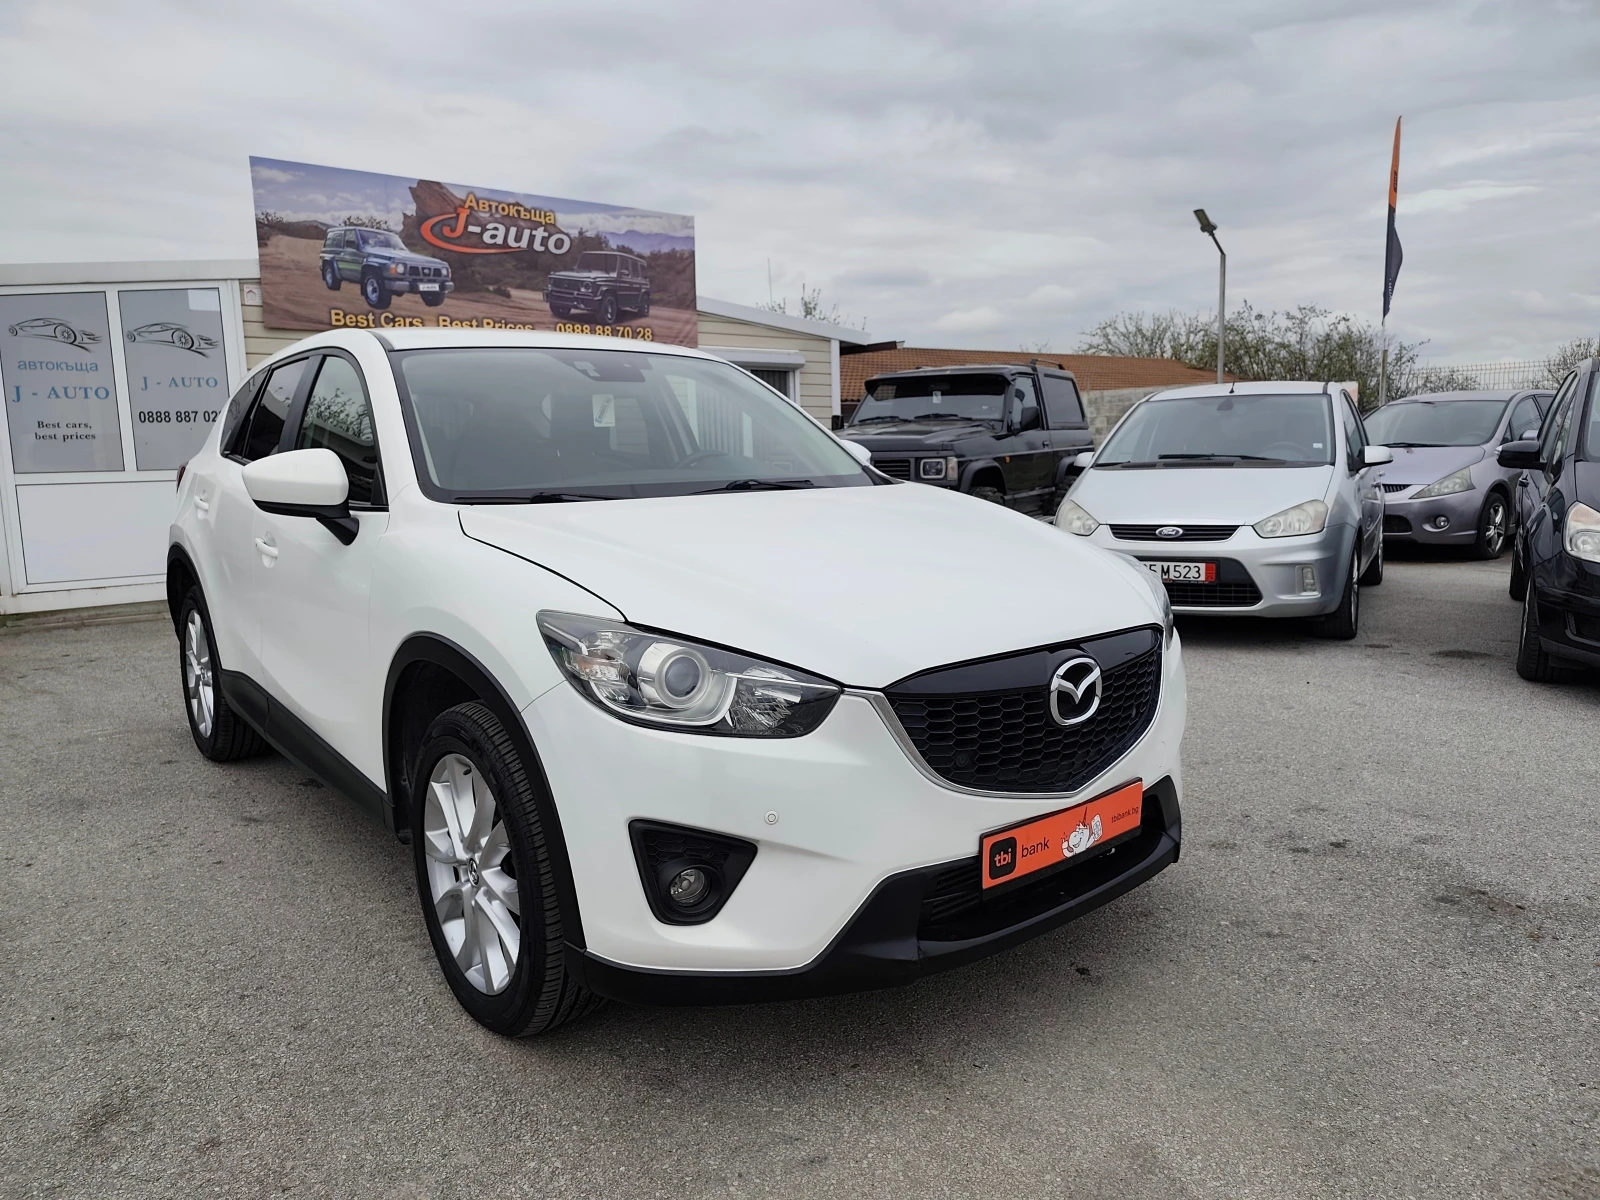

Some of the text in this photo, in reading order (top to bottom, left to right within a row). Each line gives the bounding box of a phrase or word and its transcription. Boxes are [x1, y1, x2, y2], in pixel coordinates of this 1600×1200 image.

[464, 193, 556, 225] Автокъща
[441, 207, 571, 255] J-auto
[330, 309, 376, 328] Best
[380, 312, 423, 328] Cars
[17, 360, 99, 373] автокъща
[141, 376, 149, 391] J
[168, 376, 219, 388] AUTO
[12, 385, 22, 403] J
[46, 386, 110, 400] AUTO
[138, 410, 221, 423] 0888 887 02
[37, 420, 92, 430] Best cars,
[34, 432, 97, 442] best prices
[1111, 807, 1139, 823] tbibank.bg
[994, 836, 1050, 867] tbi bank
